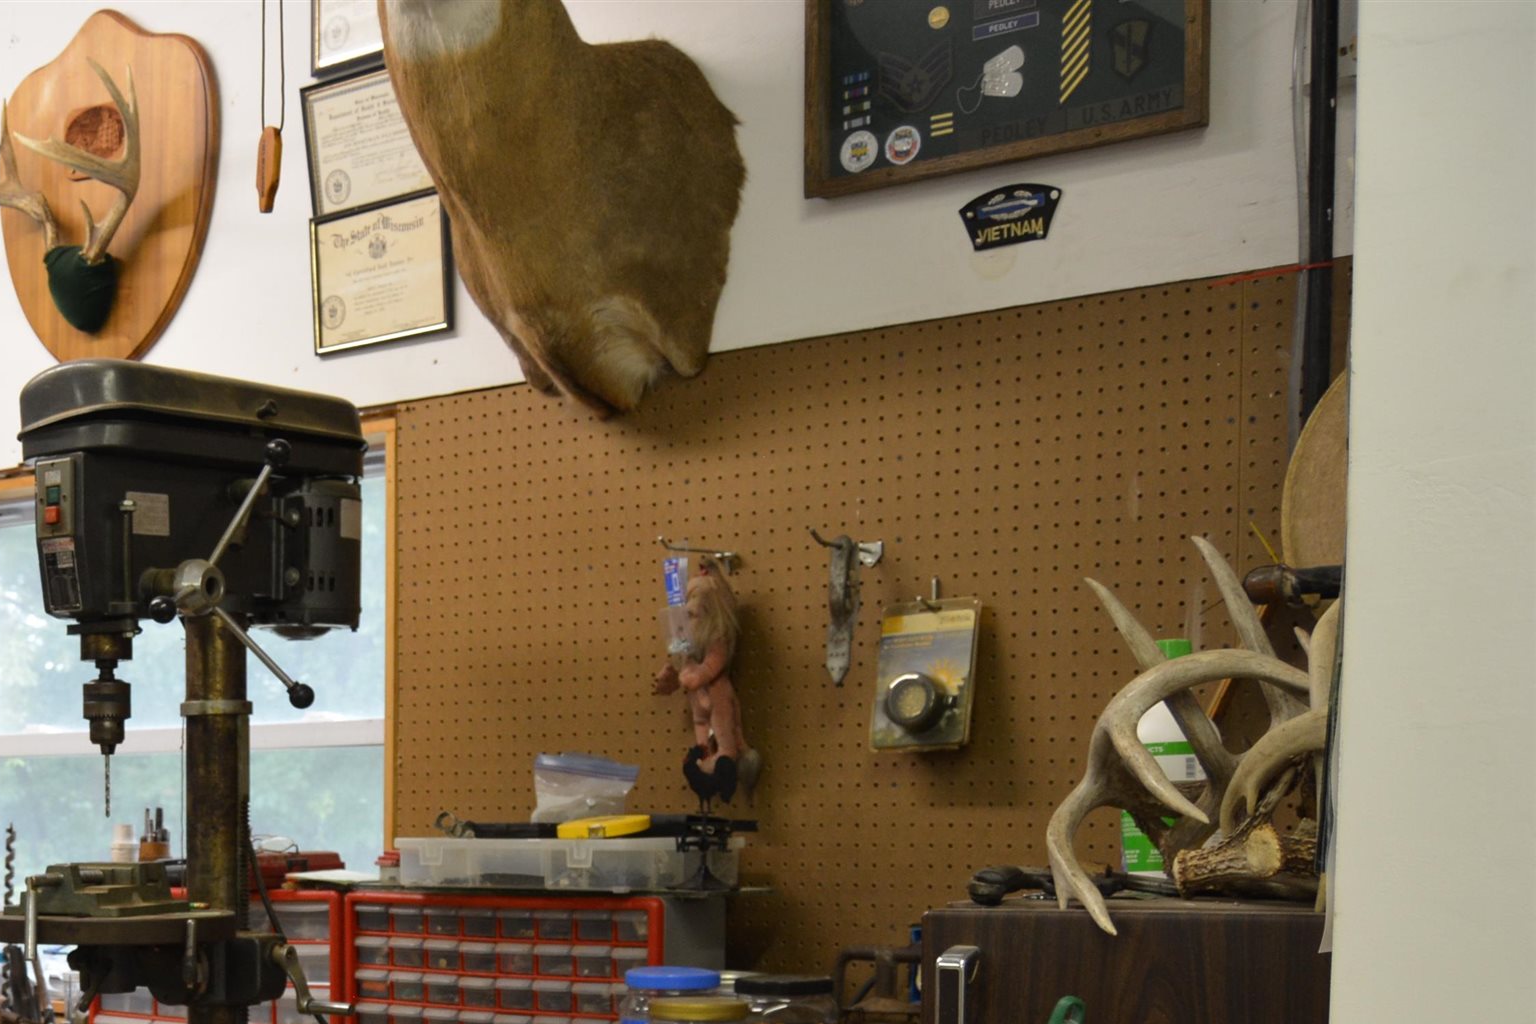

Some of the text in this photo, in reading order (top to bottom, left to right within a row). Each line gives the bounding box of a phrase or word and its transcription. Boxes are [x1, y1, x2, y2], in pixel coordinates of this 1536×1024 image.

[988, 20, 1019, 33] PEDLEY
[1119, 88, 1175, 117] ARMY
[981, 117, 1048, 145] PEDLEY
[977, 216, 1044, 243] VIETNAM
